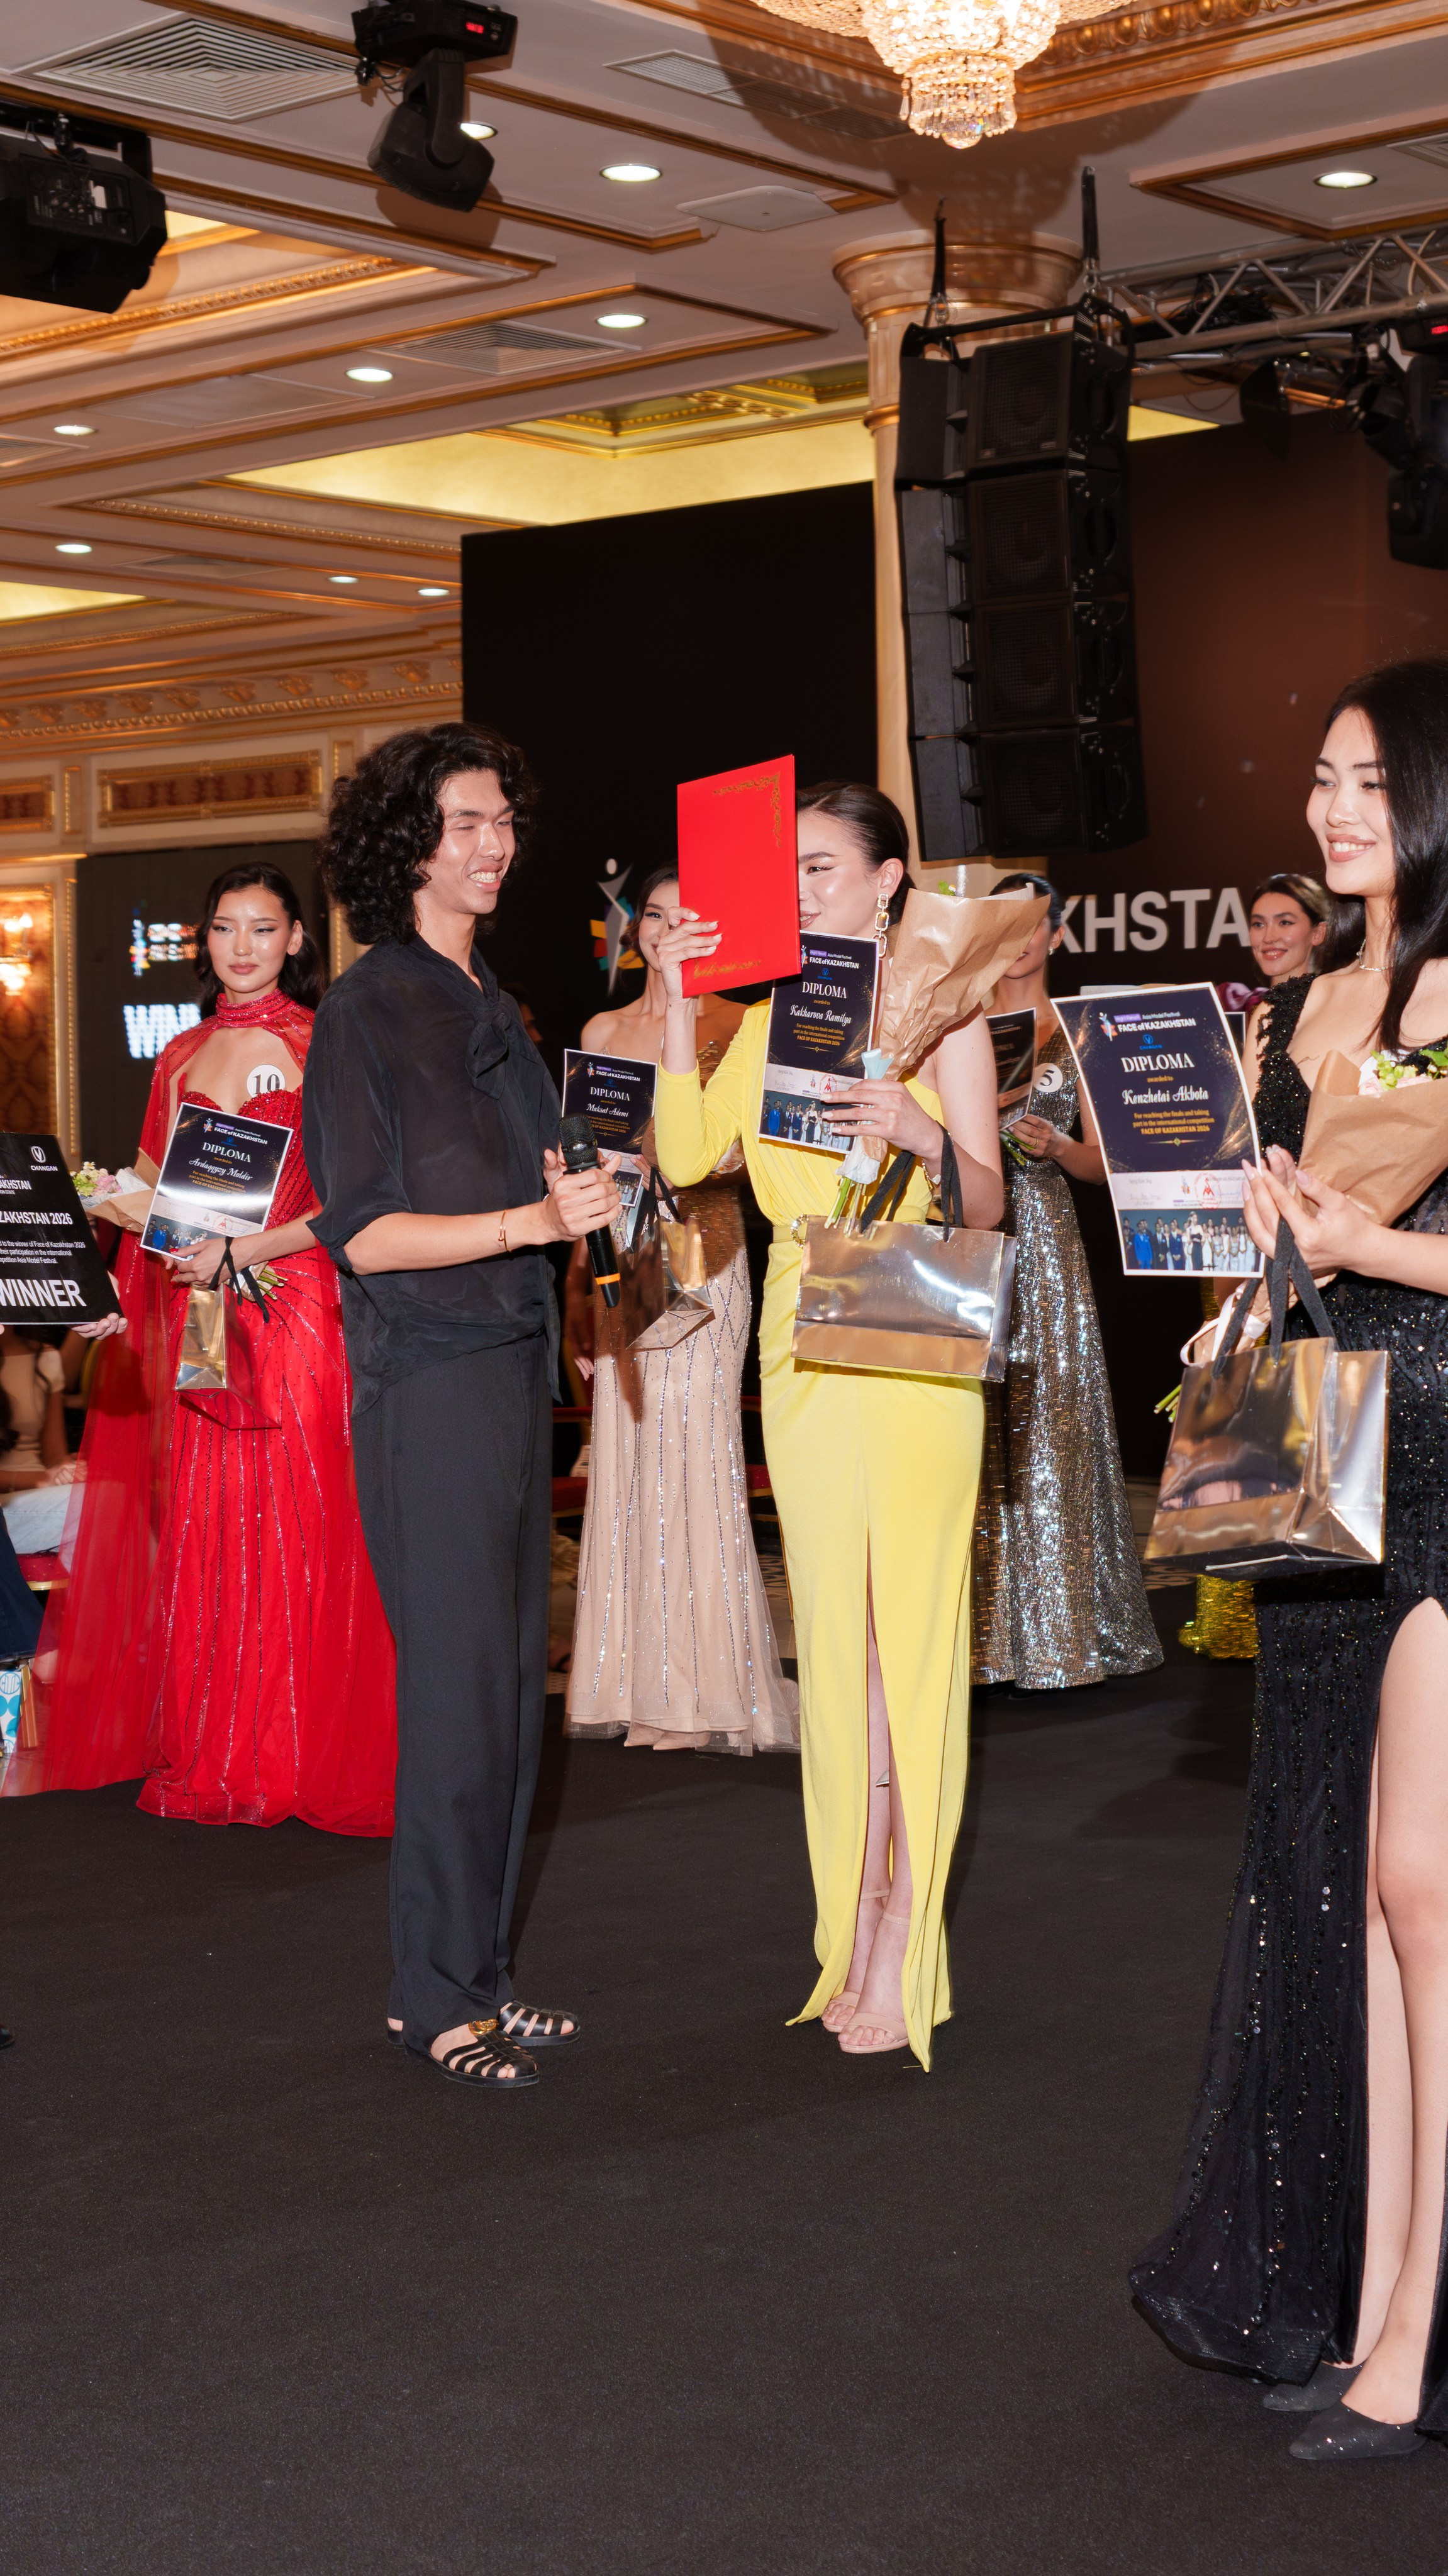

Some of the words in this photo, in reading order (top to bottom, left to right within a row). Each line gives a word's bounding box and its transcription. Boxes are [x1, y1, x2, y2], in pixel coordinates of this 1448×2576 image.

[827, 960, 859, 969] KAZAKHSTAN
[802, 982, 847, 999] DIPLOMA
[790, 1004, 823, 1019] Kakharova
[825, 1010, 852, 1027] Ramilya
[1117, 1023, 1138, 1032] FACE
[1144, 1018, 1196, 1030] KAZAKHSTAN
[1120, 1053, 1195, 1072] DIPLOMA
[252, 1074, 280, 1094] 10
[1040, 1069, 1055, 1086] 5
[590, 1087, 630, 1101] DIPLOMA
[1122, 1087, 1170, 1105] Kenzhetai
[1172, 1085, 1209, 1101] Akbota
[609, 1108, 629, 1117] Ademi
[1162, 1126, 1196, 1134] KAZAKHSTAN
[232, 1132, 268, 1145] KAZAKHSTAN
[203, 1142, 251, 1163] DIPLOMA
[227, 1168, 253, 1180] Moldir
[50, 1213, 74, 1225] 2026
[0, 1279, 87, 1306] WINNER
